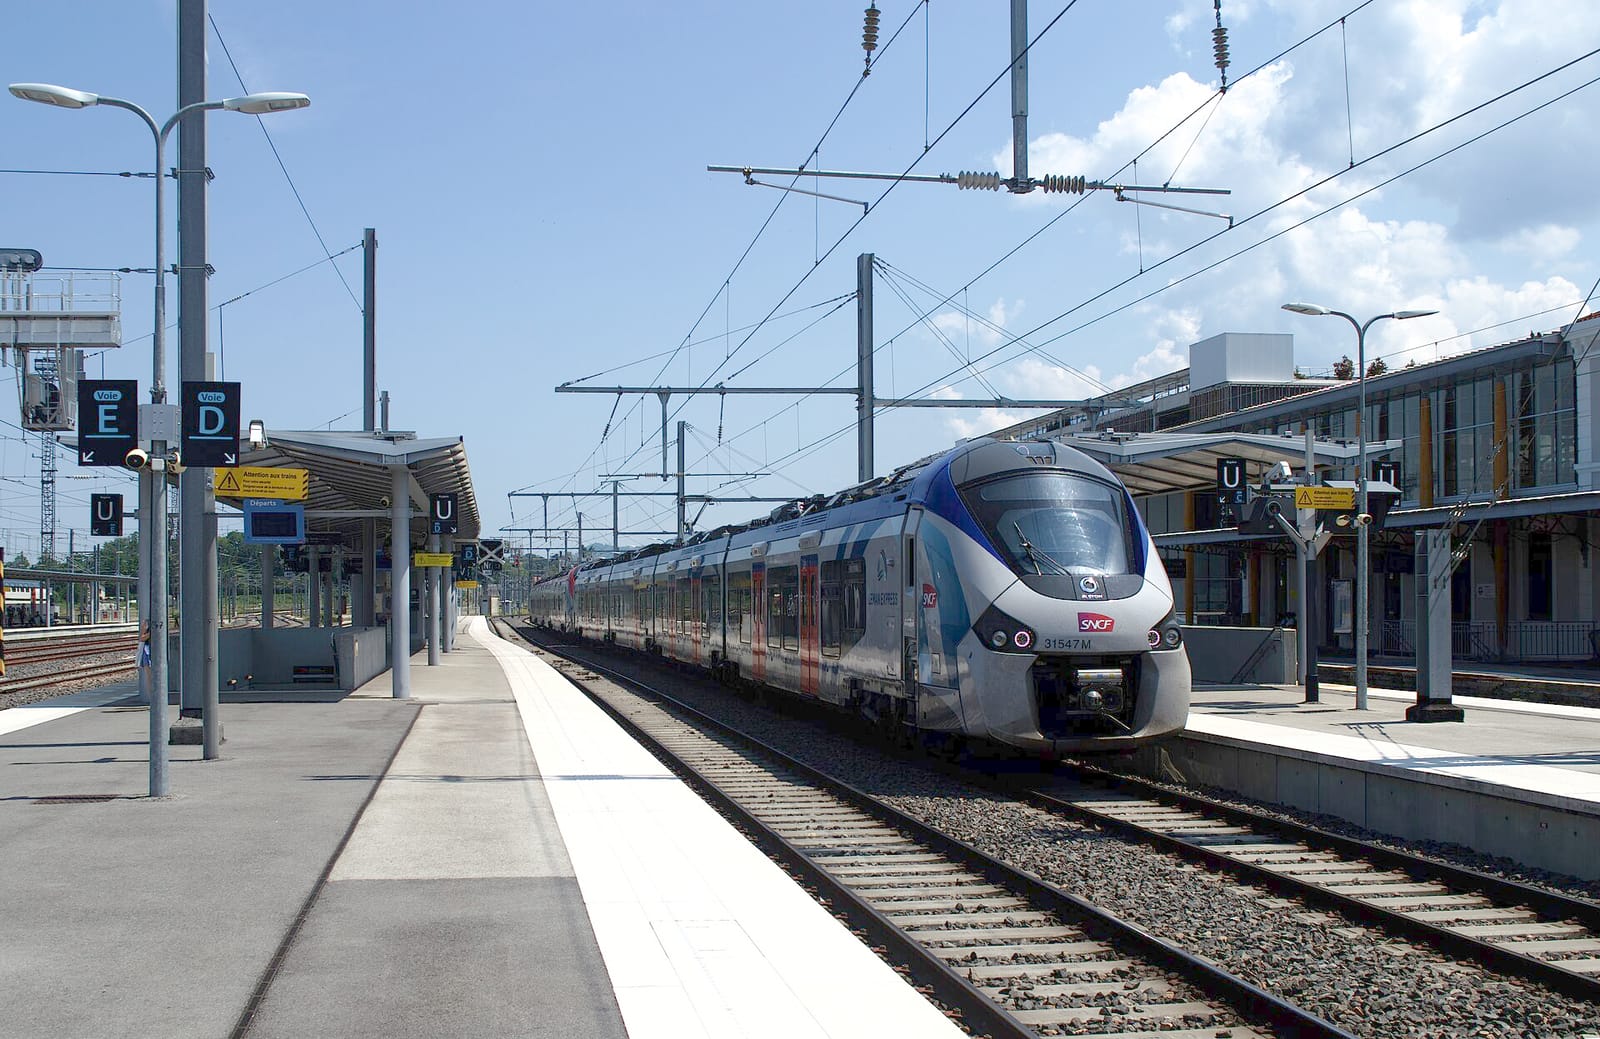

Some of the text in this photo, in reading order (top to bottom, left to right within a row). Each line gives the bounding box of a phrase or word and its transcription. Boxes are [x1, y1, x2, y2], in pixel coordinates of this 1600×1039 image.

[97, 391, 118, 400] Voie
[200, 393, 222, 401] Voie
[98, 405, 118, 432] E
[199, 406, 224, 435] D
[243, 471, 269, 479] Attention
[1224, 466, 1239, 487] U
[97, 501, 113, 520] U
[436, 500, 451, 519] U
[1080, 619, 1112, 630] SNCF
[1044, 638, 1091, 649] 31547M
